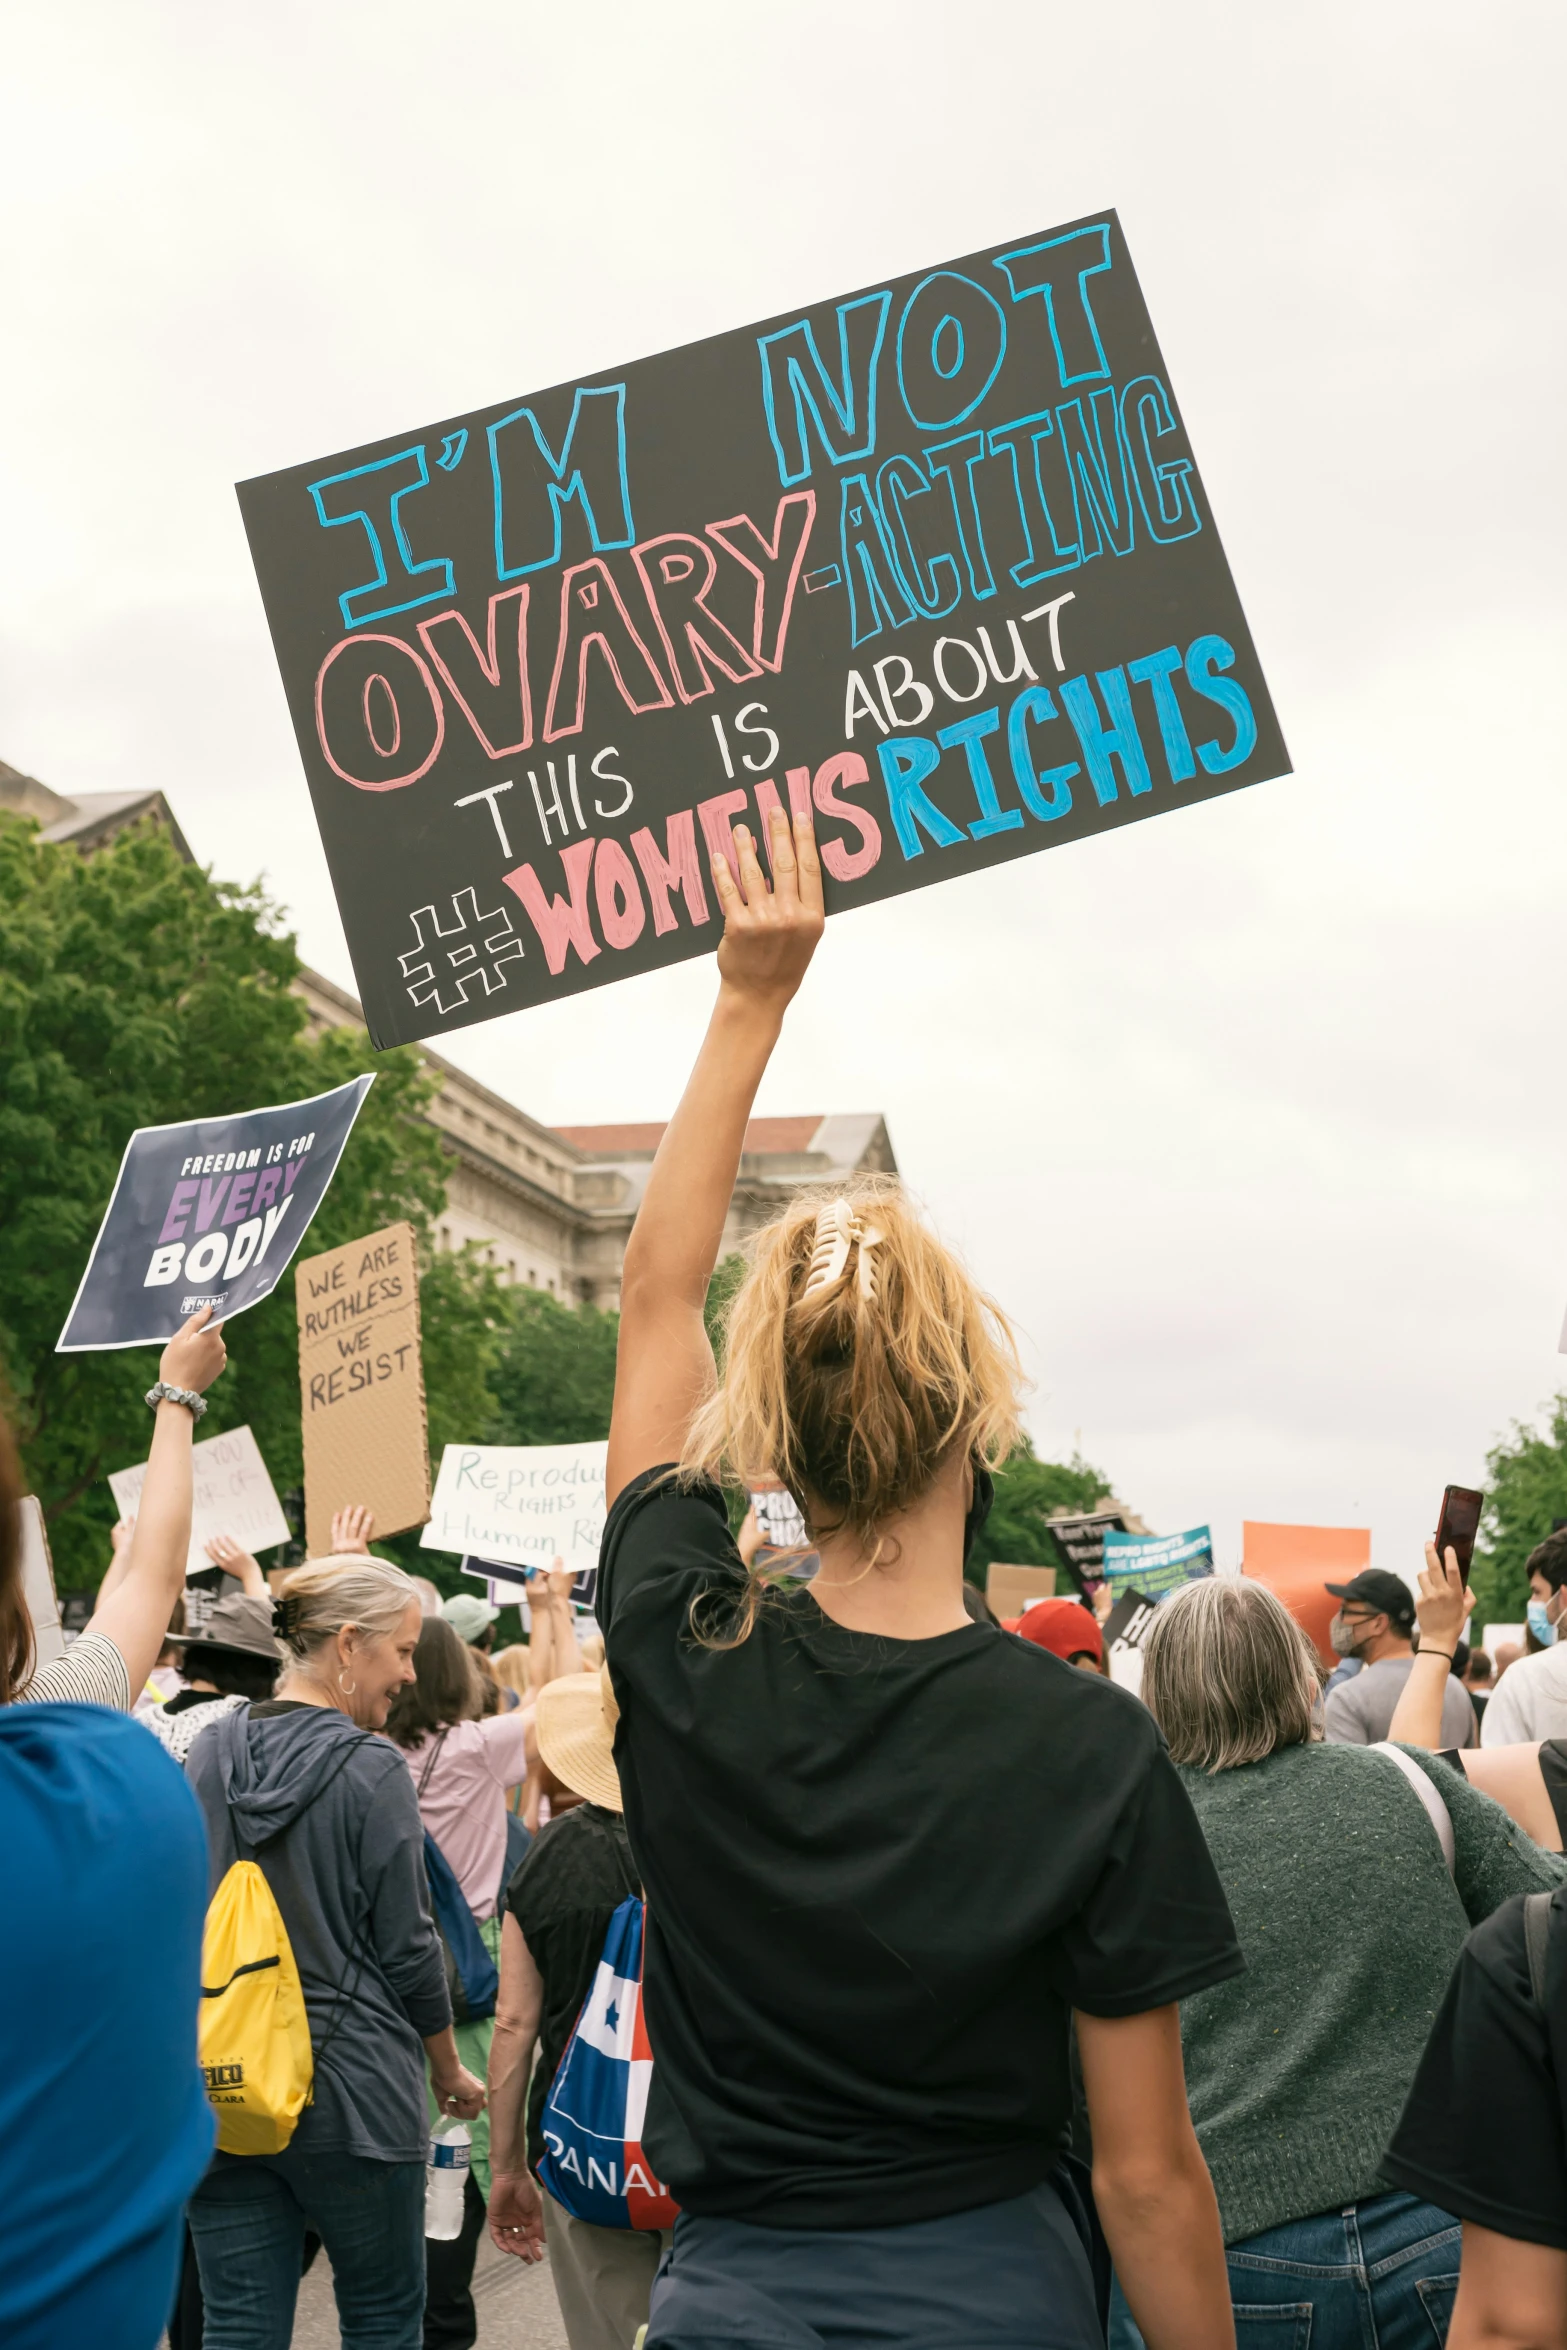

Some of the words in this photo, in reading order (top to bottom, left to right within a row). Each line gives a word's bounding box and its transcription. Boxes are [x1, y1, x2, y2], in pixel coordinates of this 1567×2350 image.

[306, 382, 636, 630] I'M
[757, 222, 1112, 489] NOT
[453, 746, 635, 859] THIS
[711, 701, 780, 779] IS
[844, 591, 1076, 740] ABOUT
[181, 1148, 262, 1177] FREEDOM
[266, 1143, 284, 1165] IS
[288, 1132, 316, 1159] FOR
[157, 1155, 308, 1245] EVERY
[143, 1193, 295, 1288] BODY
[308, 1260, 347, 1298] WE
[358, 1240, 399, 1279] ARE
[305, 1276, 403, 1338] RUTHLESS
[337, 1324, 373, 1359] WE
[310, 1344, 412, 1412] RESIST
[442, 1510, 556, 1556] Human
[202, 2063, 243, 2086] FICO
[542, 2129, 668, 2198] PANA
